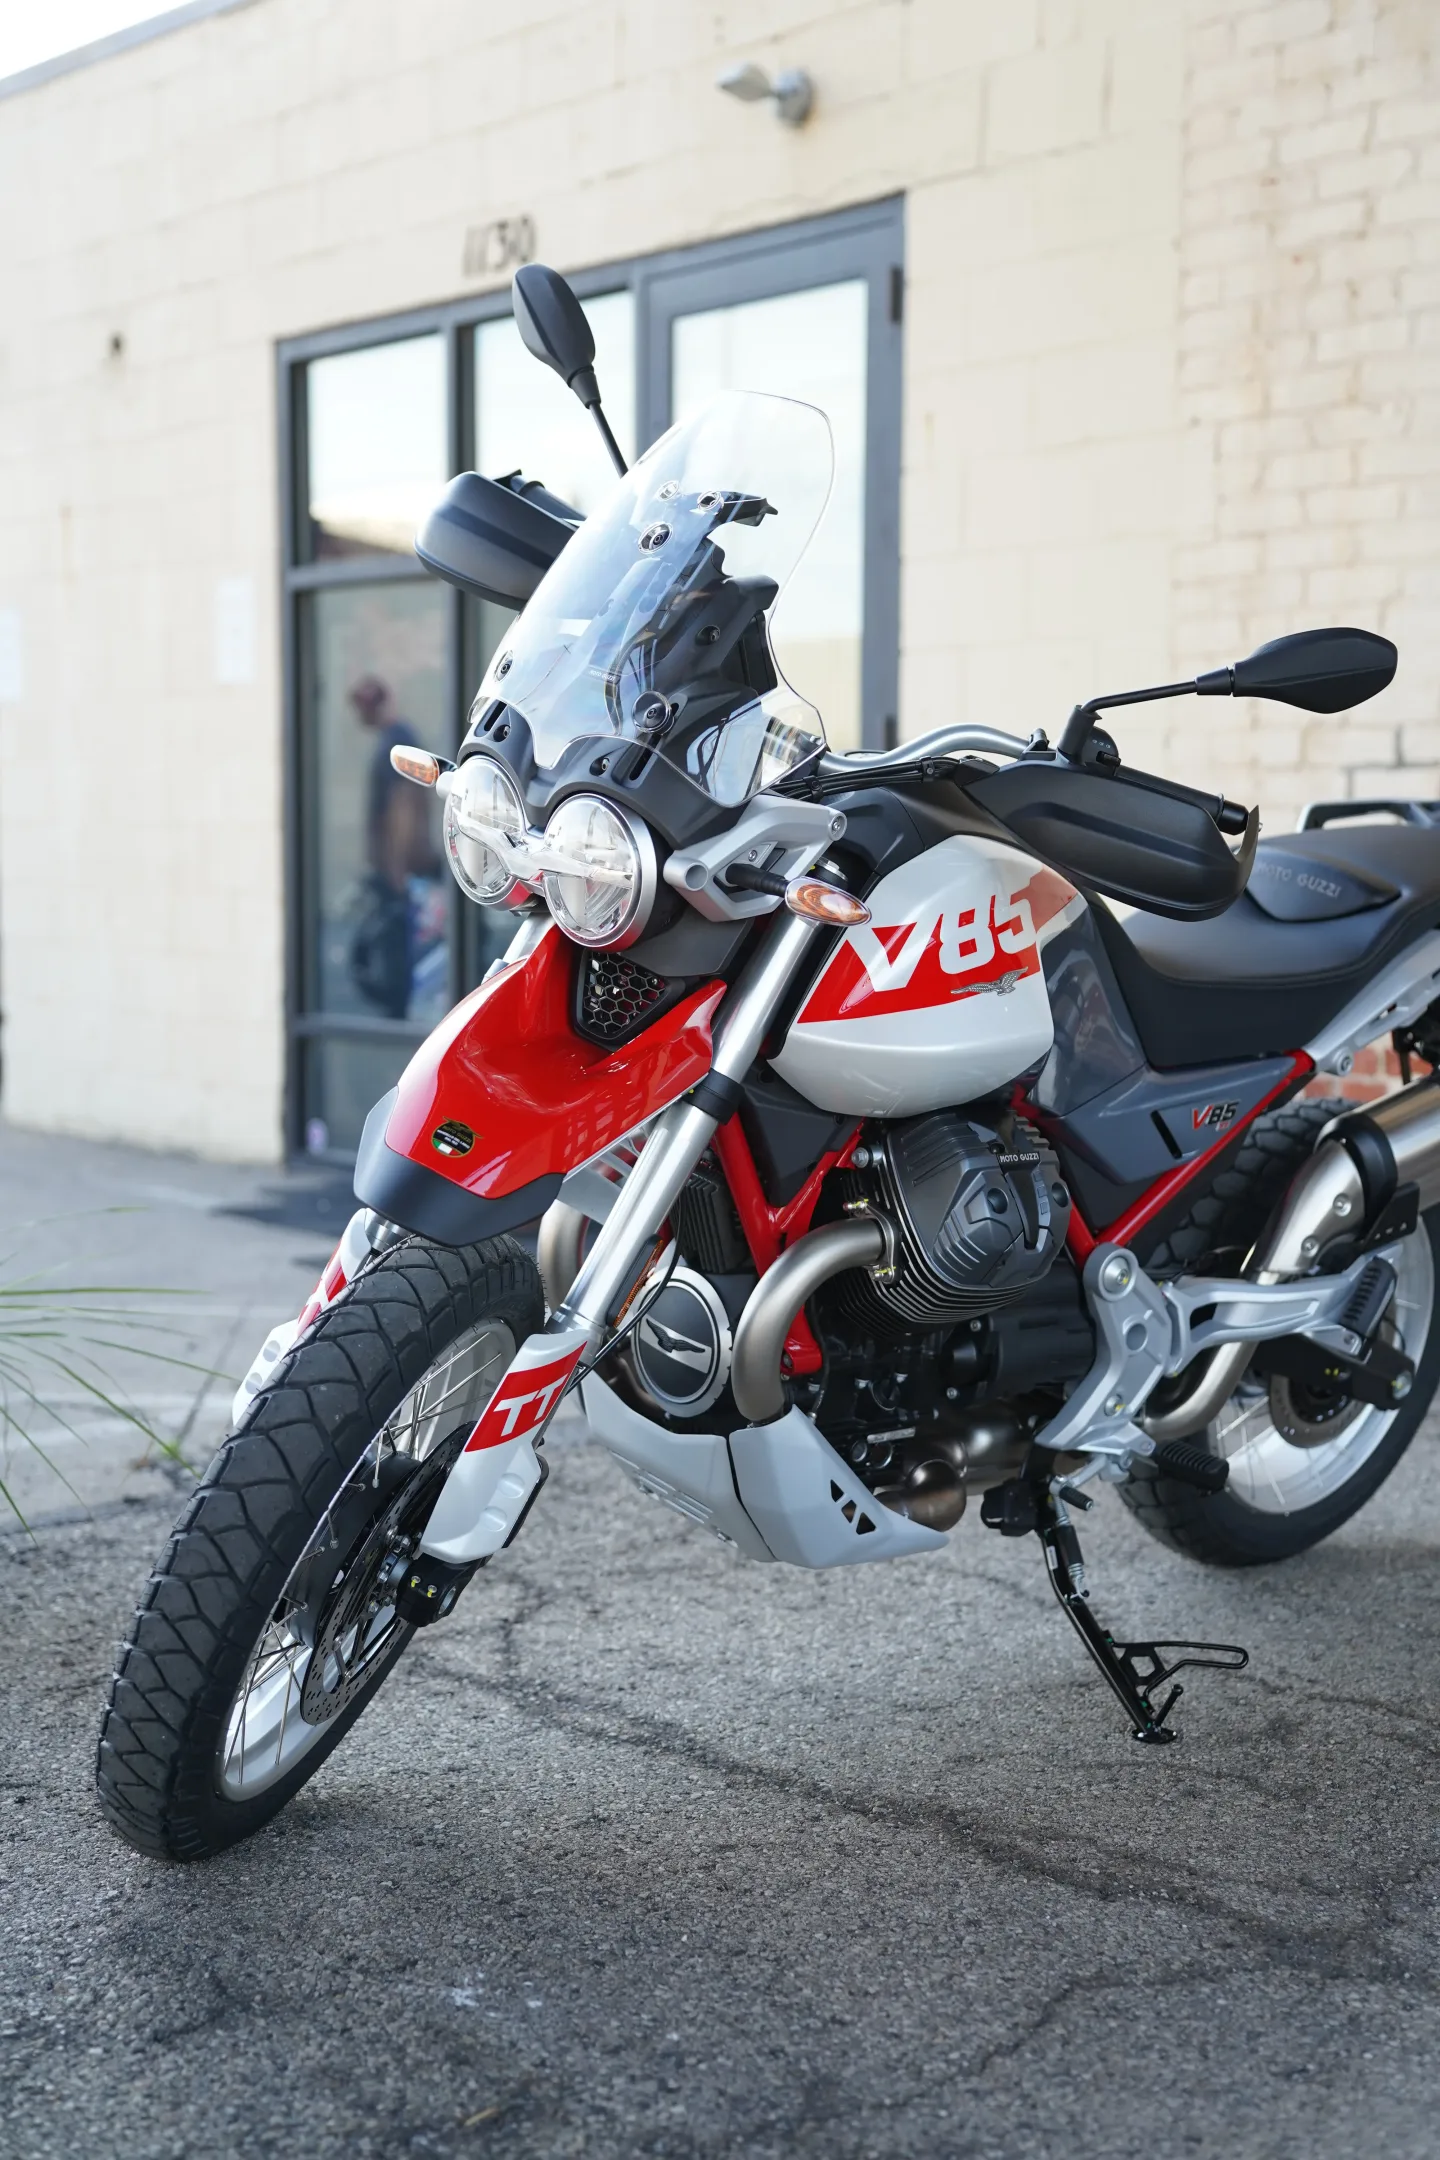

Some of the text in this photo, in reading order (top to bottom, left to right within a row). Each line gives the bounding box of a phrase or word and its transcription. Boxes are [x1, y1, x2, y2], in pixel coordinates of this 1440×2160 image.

[1256, 861, 1342, 898] MOTO GUZZI
[846, 880, 1037, 992] V85
[1193, 1101, 1240, 1131] V85
[1000, 1152, 1040, 1163] MOTO GUZZI
[493, 1373, 569, 1437] TT
